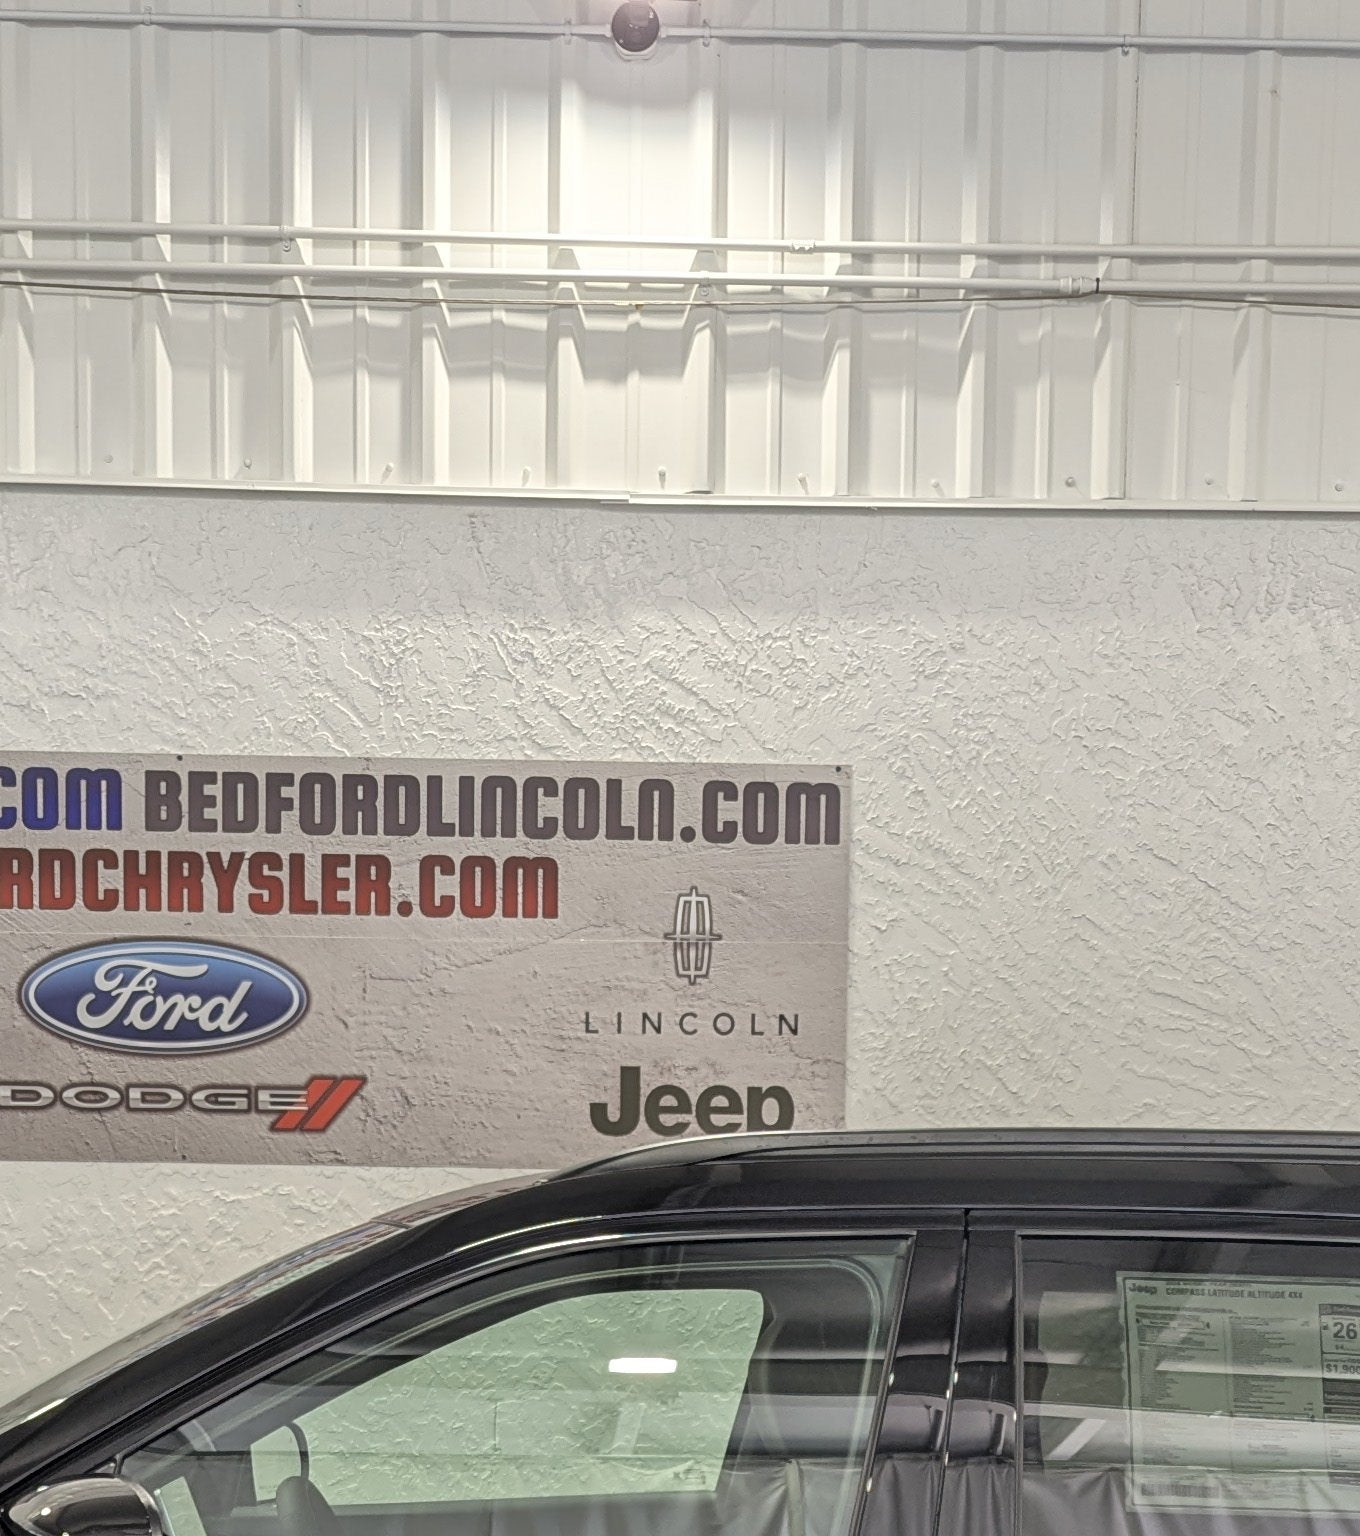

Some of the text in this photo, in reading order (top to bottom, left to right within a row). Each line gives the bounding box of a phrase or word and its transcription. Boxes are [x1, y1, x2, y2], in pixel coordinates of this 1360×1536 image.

[145, 770, 841, 846] BEDFORDLINCOLN.COM
[75, 960, 251, 1032] Ford
[585, 1012, 800, 1036] LINCOLN
[590, 1066, 796, 1136] Jeep
[1128, 1282, 1158, 1296] Jeep
[1165, 1287, 1206, 1297] COMPASS
[1208, 1288, 1244, 1298] LATITUDE
[1247, 1289, 1285, 1299] ALTITUDE
[1332, 1322, 1358, 1340] 26
